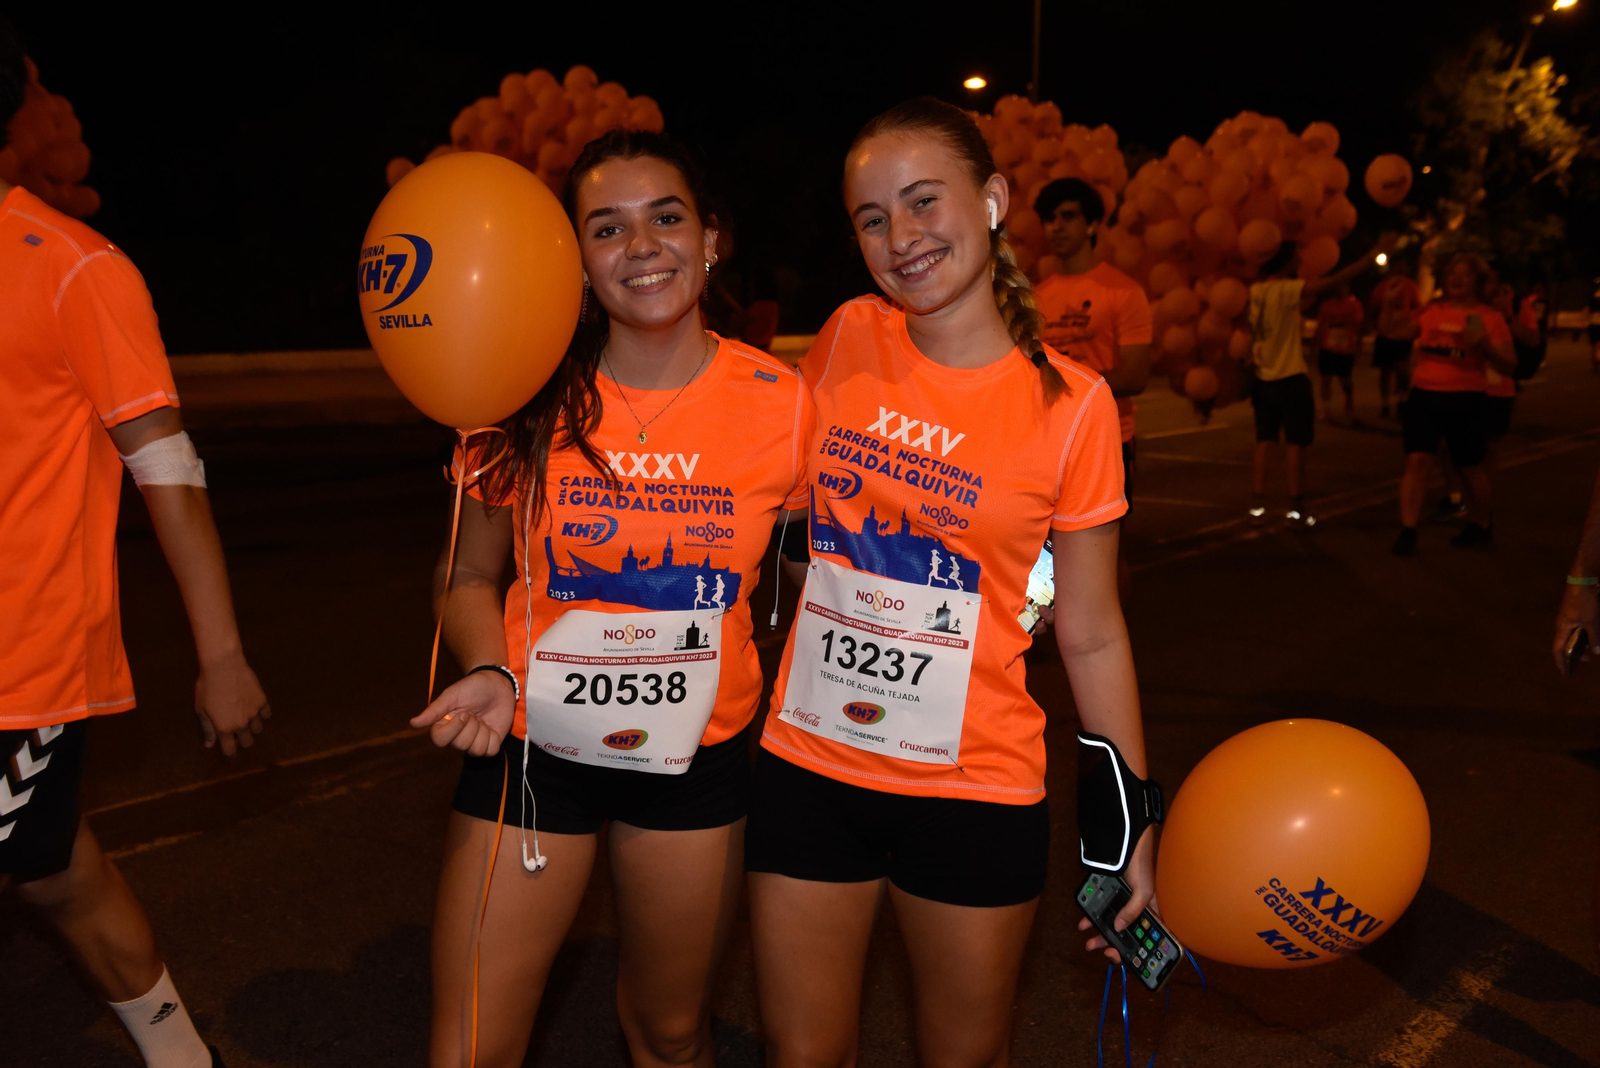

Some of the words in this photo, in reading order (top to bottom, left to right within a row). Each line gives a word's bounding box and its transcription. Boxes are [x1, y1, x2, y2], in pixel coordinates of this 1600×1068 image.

[360, 244, 385, 260] TURNA
[379, 314, 433, 329] SEVILLA
[865, 405, 967, 457] XXXV
[819, 437, 831, 454] DEL
[828, 425, 890, 456] CARRERA
[896, 448, 983, 490] NOCTURNA
[604, 449, 700, 480] XXXV
[827, 442, 978, 509] GUADALQUIVIR
[558, 487, 567, 506] DEL
[559, 476, 642, 494] CARRERA
[644, 483, 735, 498] NOCTURNA
[569, 491, 735, 516] GUADALQUIVIR
[812, 539, 836, 551] 2023
[549, 588, 576, 600] 2023
[807, 603, 821, 613] XXXV
[821, 607, 842, 622] CARRERA
[872, 625, 883, 633] DEL
[933, 637, 947, 645] KH7
[947, 639, 964, 647] 2023
[558, 655, 588, 663] CARRERA
[639, 655, 685, 663] GUADALQUIVIR
[821, 629, 933, 686] 13237
[563, 671, 687, 706] 20538
[820, 670, 844, 685] TERESA
[846, 678, 856, 688] DE
[856, 681, 886, 697] ACUÑA
[888, 690, 920, 703] TEJADA
[899, 740, 949, 756] Cruzcampo
[1255, 885, 1269, 896] DEL
[1268, 877, 1323, 928] CARRERA
[1299, 876, 1384, 938] XXXV
